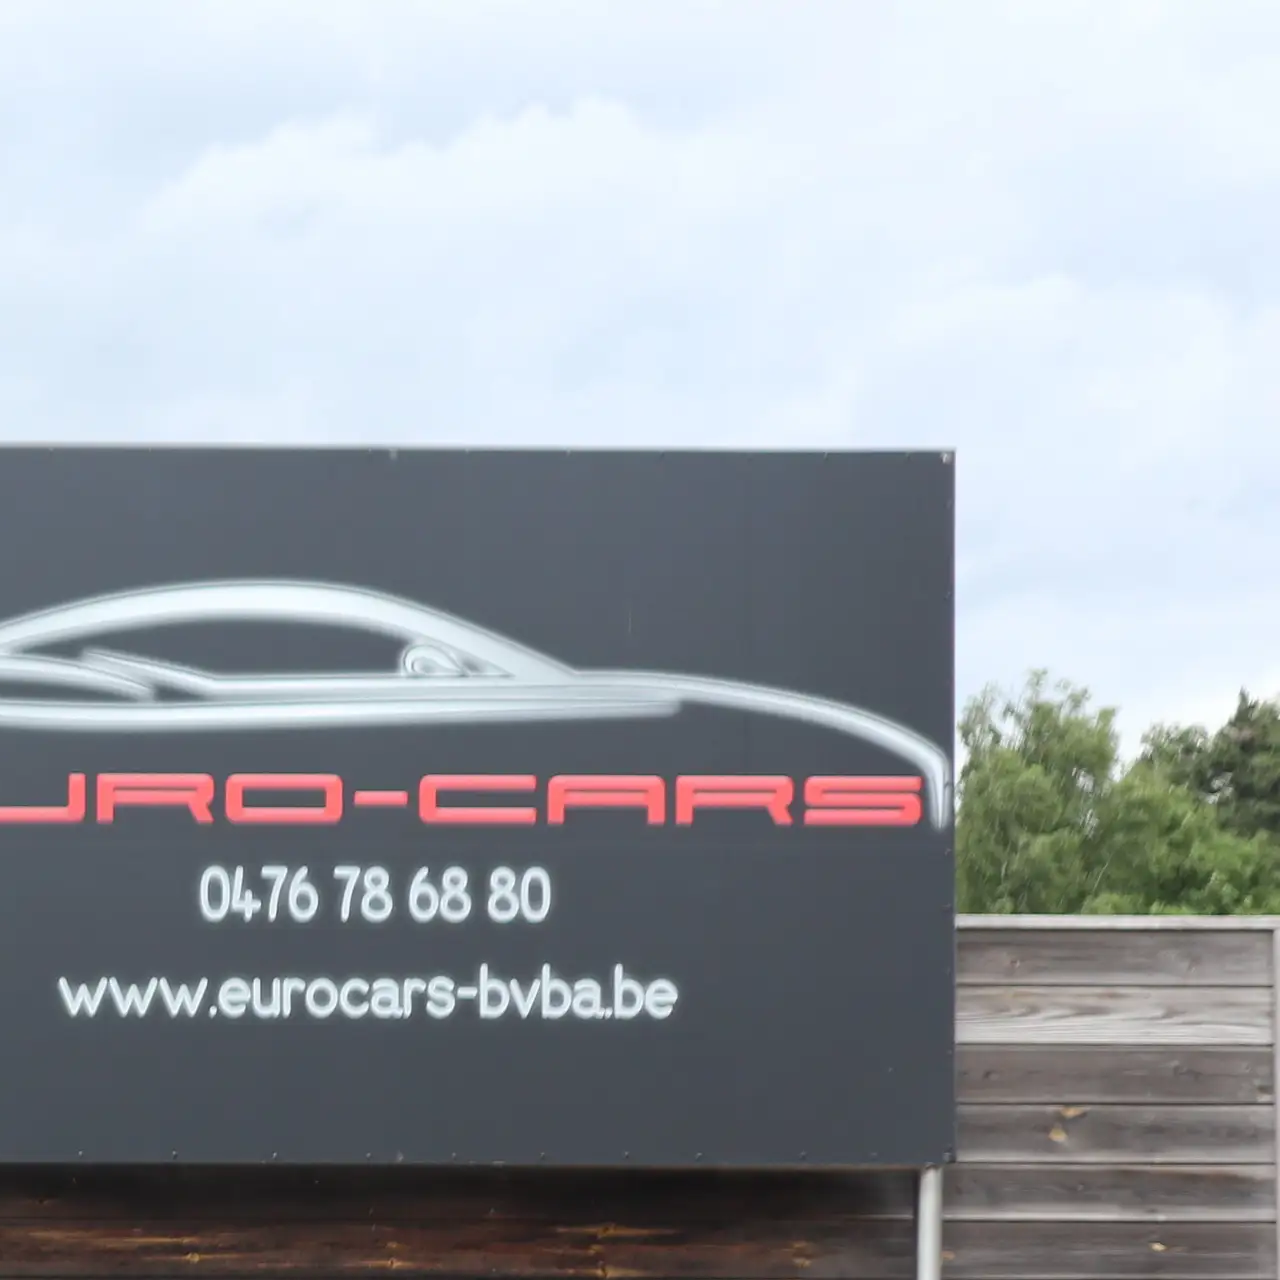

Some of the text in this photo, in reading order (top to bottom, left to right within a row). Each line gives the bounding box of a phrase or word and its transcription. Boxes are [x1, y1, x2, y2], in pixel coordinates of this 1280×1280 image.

[197, 864, 553, 925] 0476 78 68 80
[56, 961, 680, 1020] www.eurocars-bvba.be
